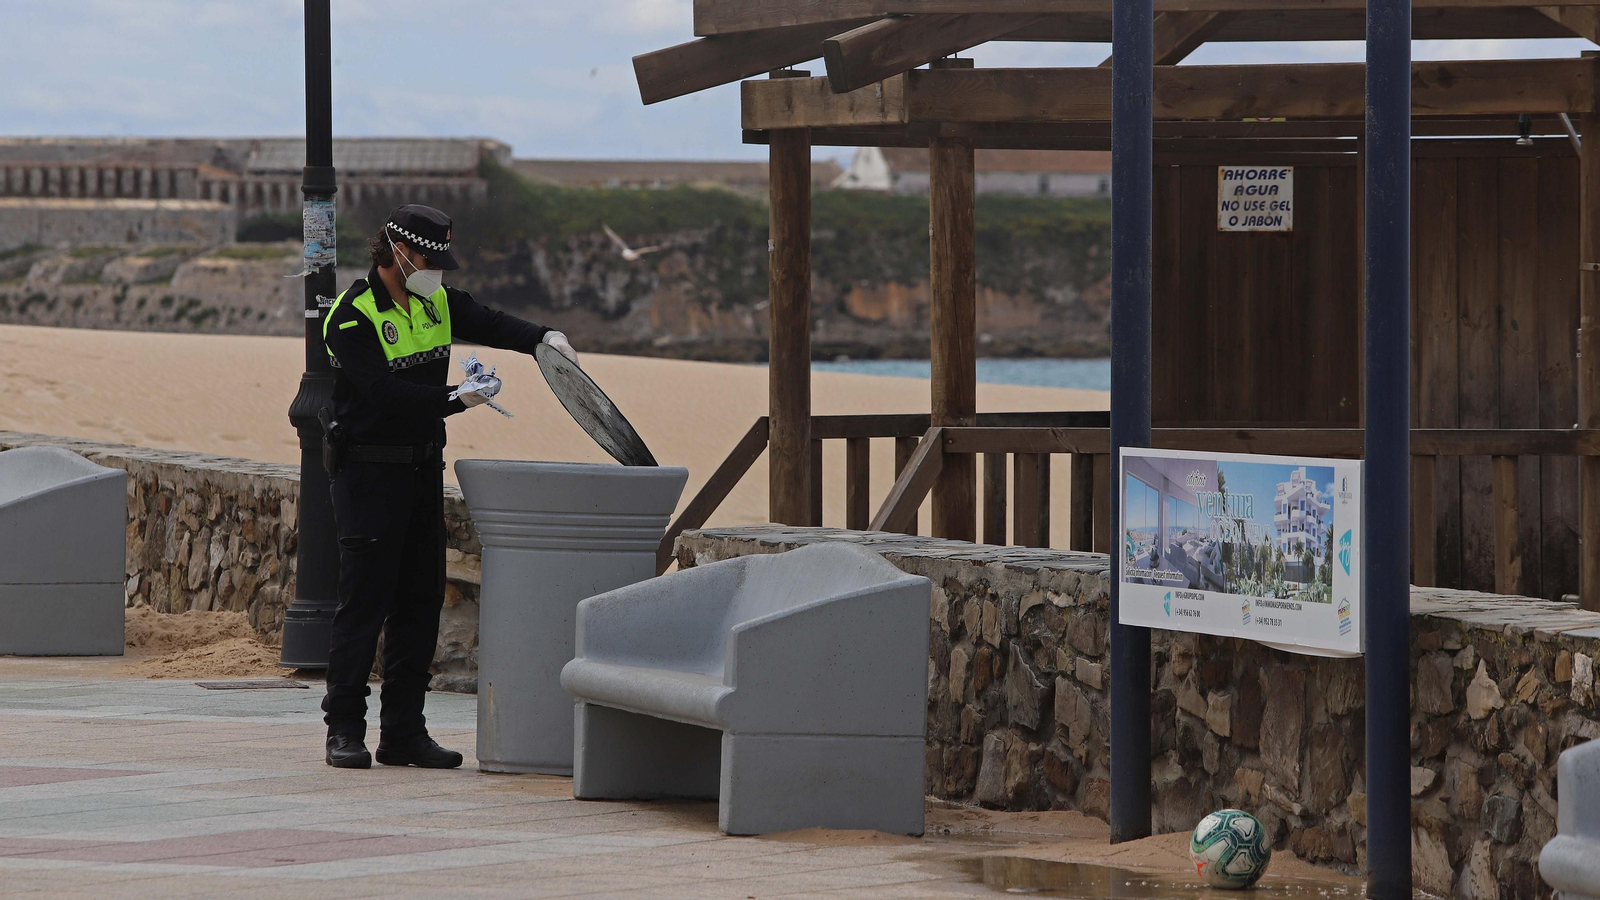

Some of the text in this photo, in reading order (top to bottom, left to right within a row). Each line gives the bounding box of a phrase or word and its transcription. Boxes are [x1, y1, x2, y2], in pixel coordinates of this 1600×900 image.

[1223, 169, 1288, 180] AHORRE
[1234, 185, 1279, 196] AGUA
[1221, 200, 1291, 211] NO USE GEL
[1228, 212, 1283, 226] O JABÓN
[1196, 487, 1254, 519] ventura
[1210, 519, 1242, 544] OCEAN
